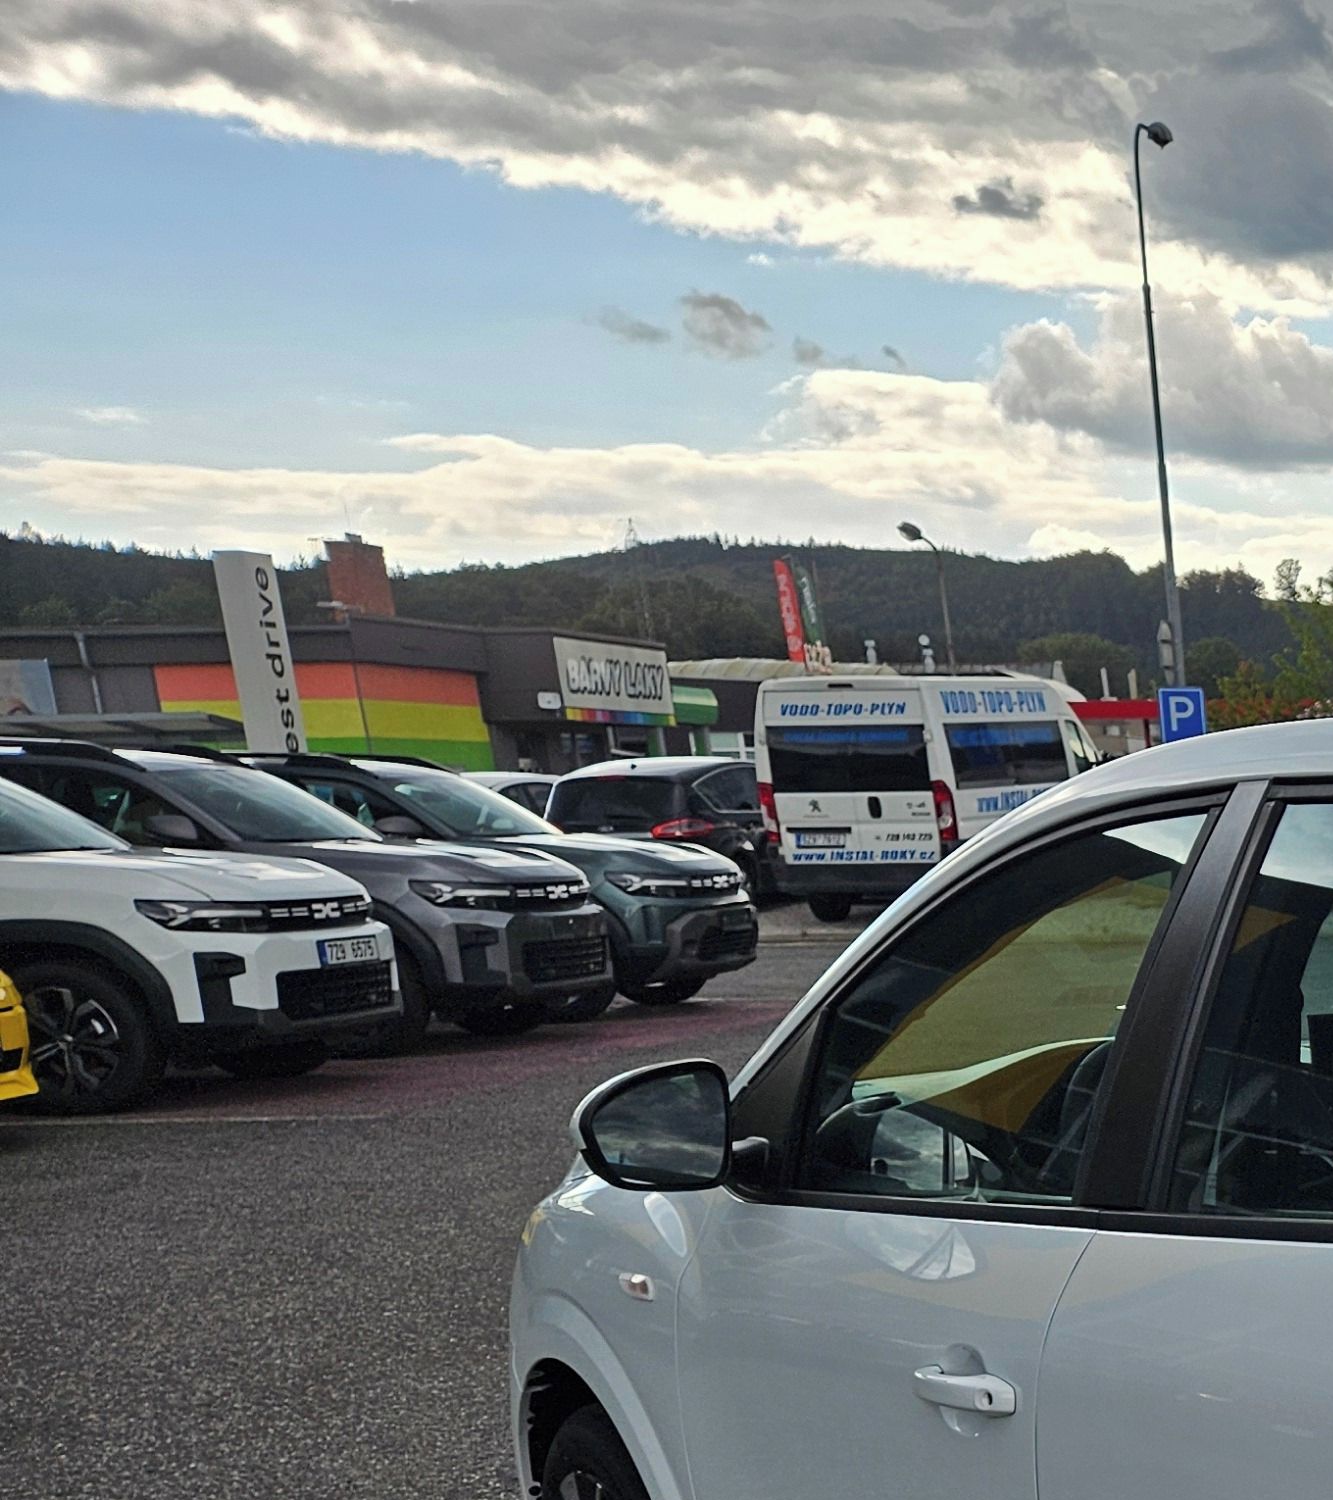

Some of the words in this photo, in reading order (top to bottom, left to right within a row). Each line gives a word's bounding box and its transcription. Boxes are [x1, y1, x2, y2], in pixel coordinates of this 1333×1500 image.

[255, 566, 285, 679] drive
[566, 657, 621, 697] BARVY
[623, 661, 664, 701] LAKY
[1168, 695, 1195, 732] P
